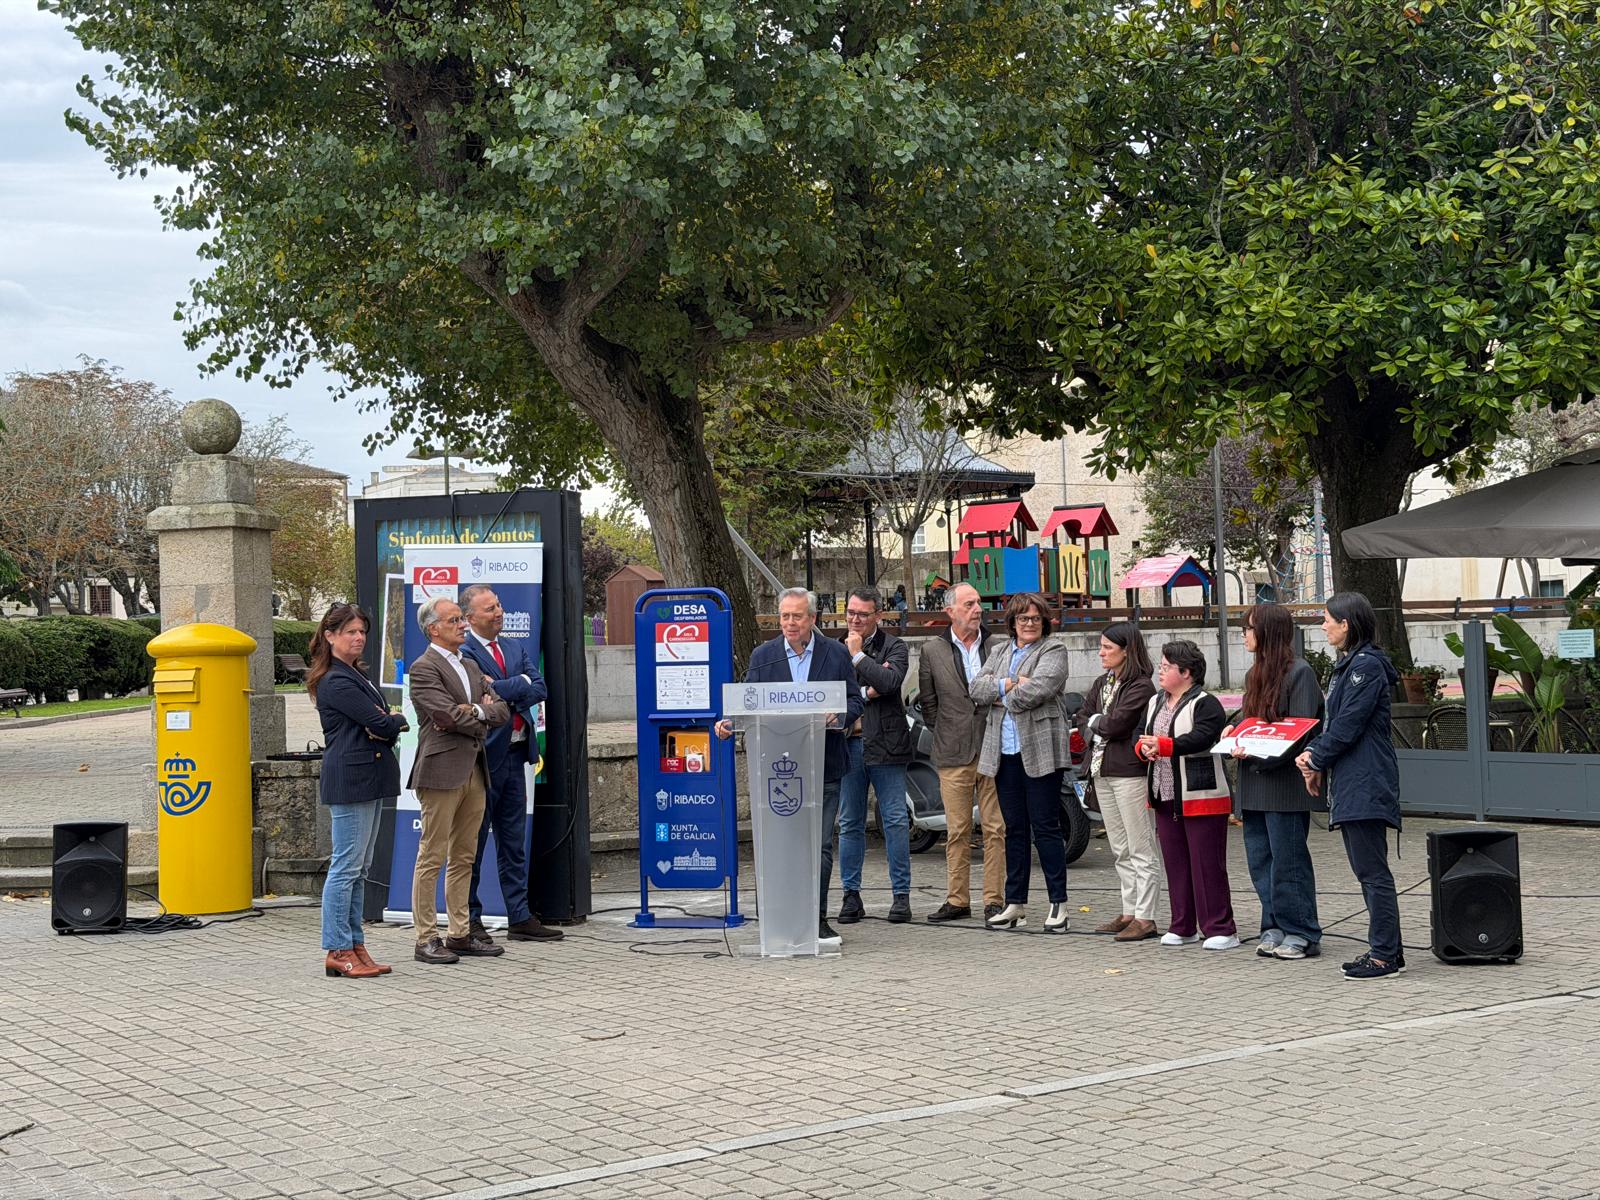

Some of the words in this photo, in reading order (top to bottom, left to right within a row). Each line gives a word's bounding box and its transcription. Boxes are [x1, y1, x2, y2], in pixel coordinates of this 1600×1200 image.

[389, 530, 455, 547] Sinfonía
[460, 528, 479, 543] de
[488, 562, 529, 573] RIBADEO
[673, 604, 707, 615] DESA
[769, 691, 826, 704] RIBADEO
[674, 794, 716, 804] RIBADEO
[670, 832, 681, 840] DE
[683, 832, 716, 840] GALICIA
